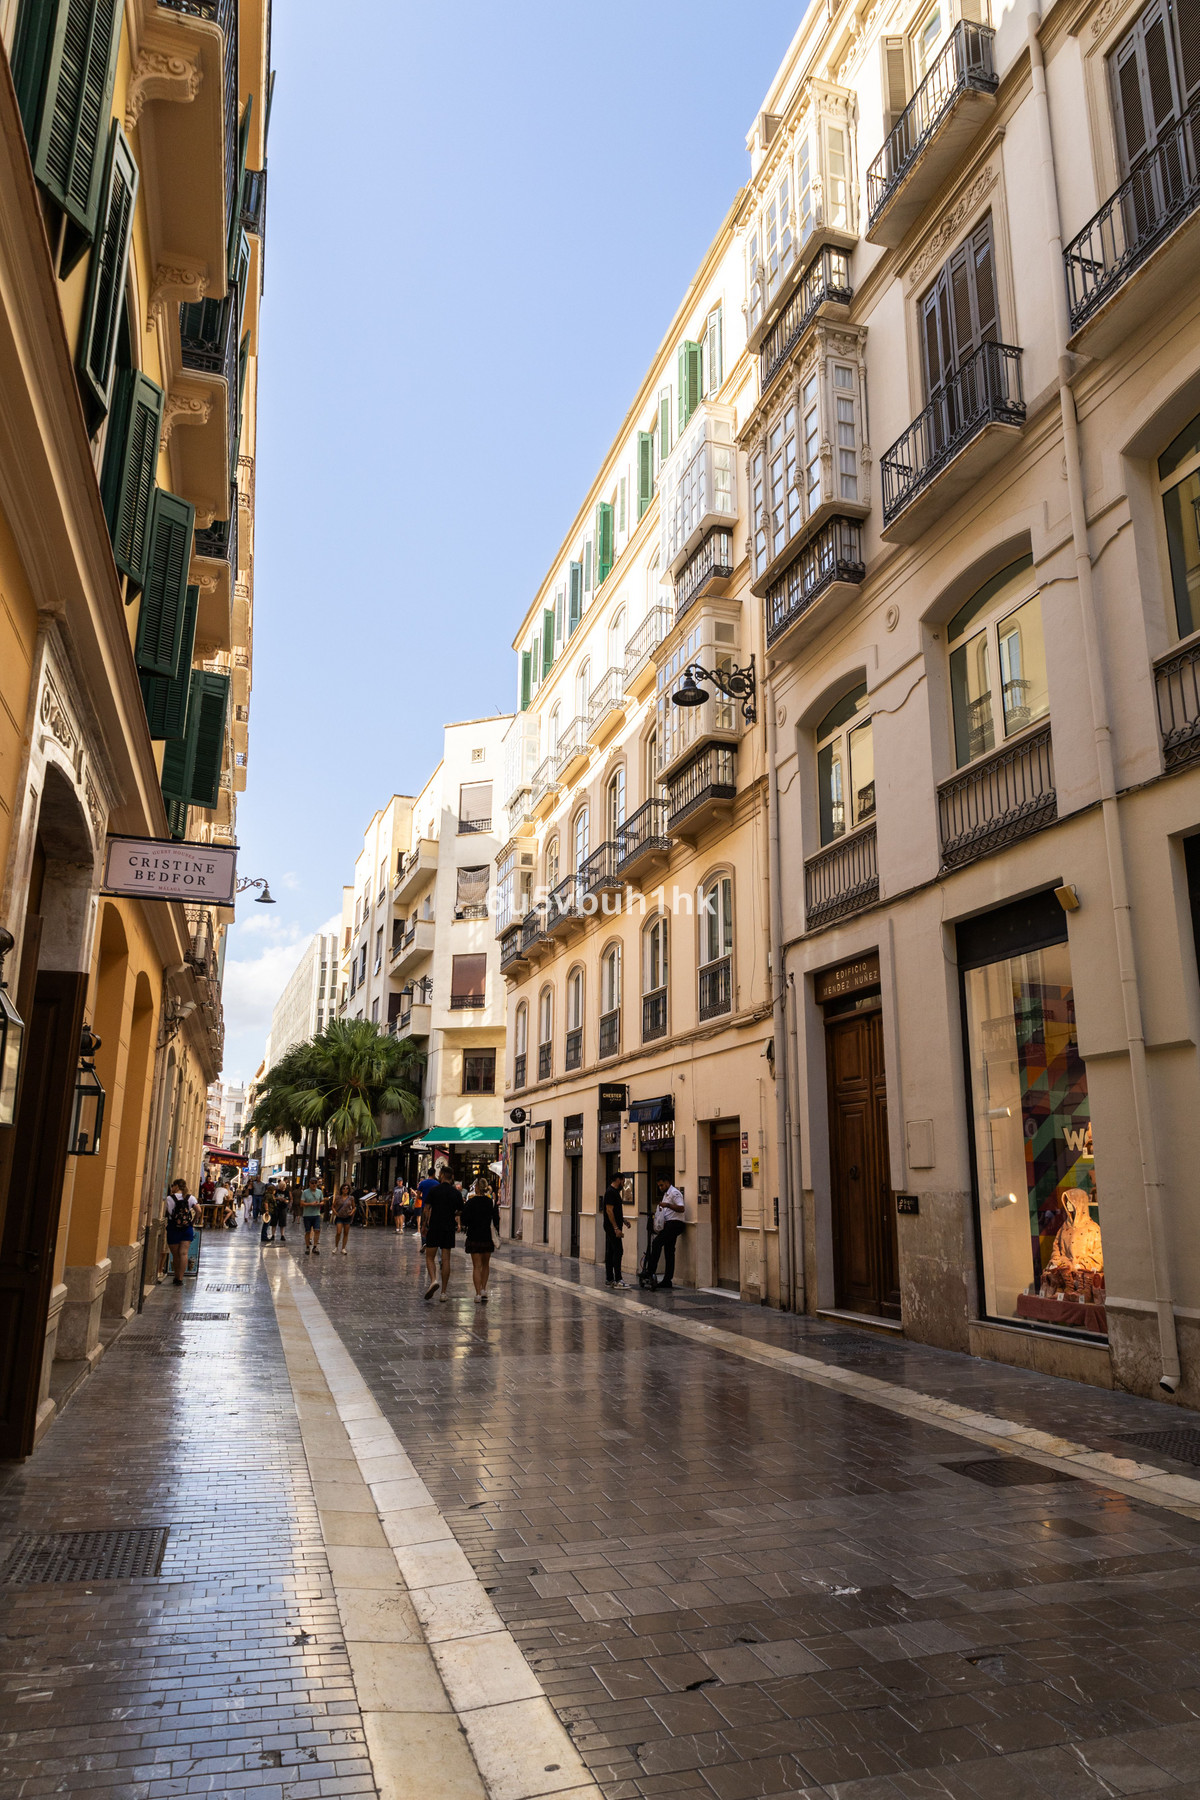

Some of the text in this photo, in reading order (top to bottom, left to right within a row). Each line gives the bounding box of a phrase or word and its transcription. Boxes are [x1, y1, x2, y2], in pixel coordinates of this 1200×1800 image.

[128, 856, 215, 873] CRISTINE
[134, 869, 206, 885] BEDFOR
[836, 962, 867, 979] EDIFICIO
[823, 981, 850, 995] MENDEZ
